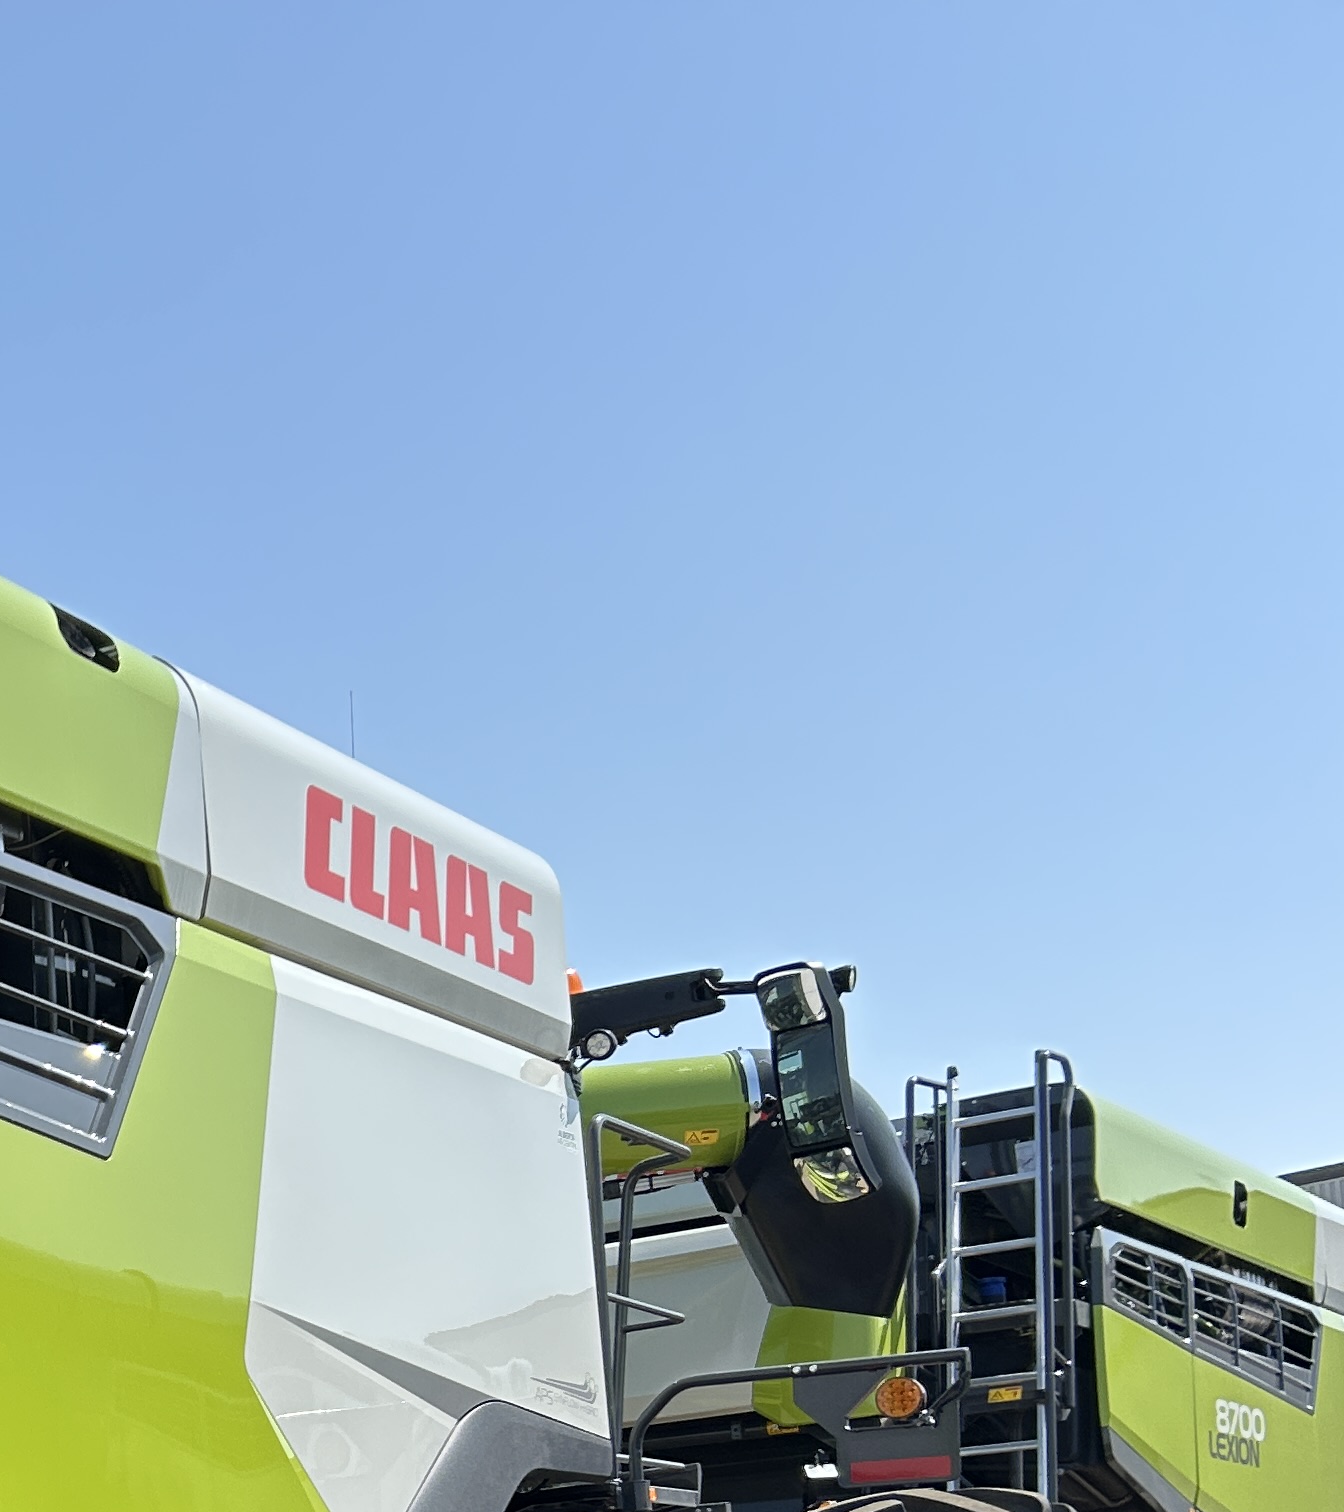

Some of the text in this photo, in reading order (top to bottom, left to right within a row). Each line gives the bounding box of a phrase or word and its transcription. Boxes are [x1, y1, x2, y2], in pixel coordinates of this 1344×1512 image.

[303, 783, 535, 986] CLAAS
[1215, 1398, 1266, 1442] 8700
[1208, 1430, 1261, 1469] LEXION
